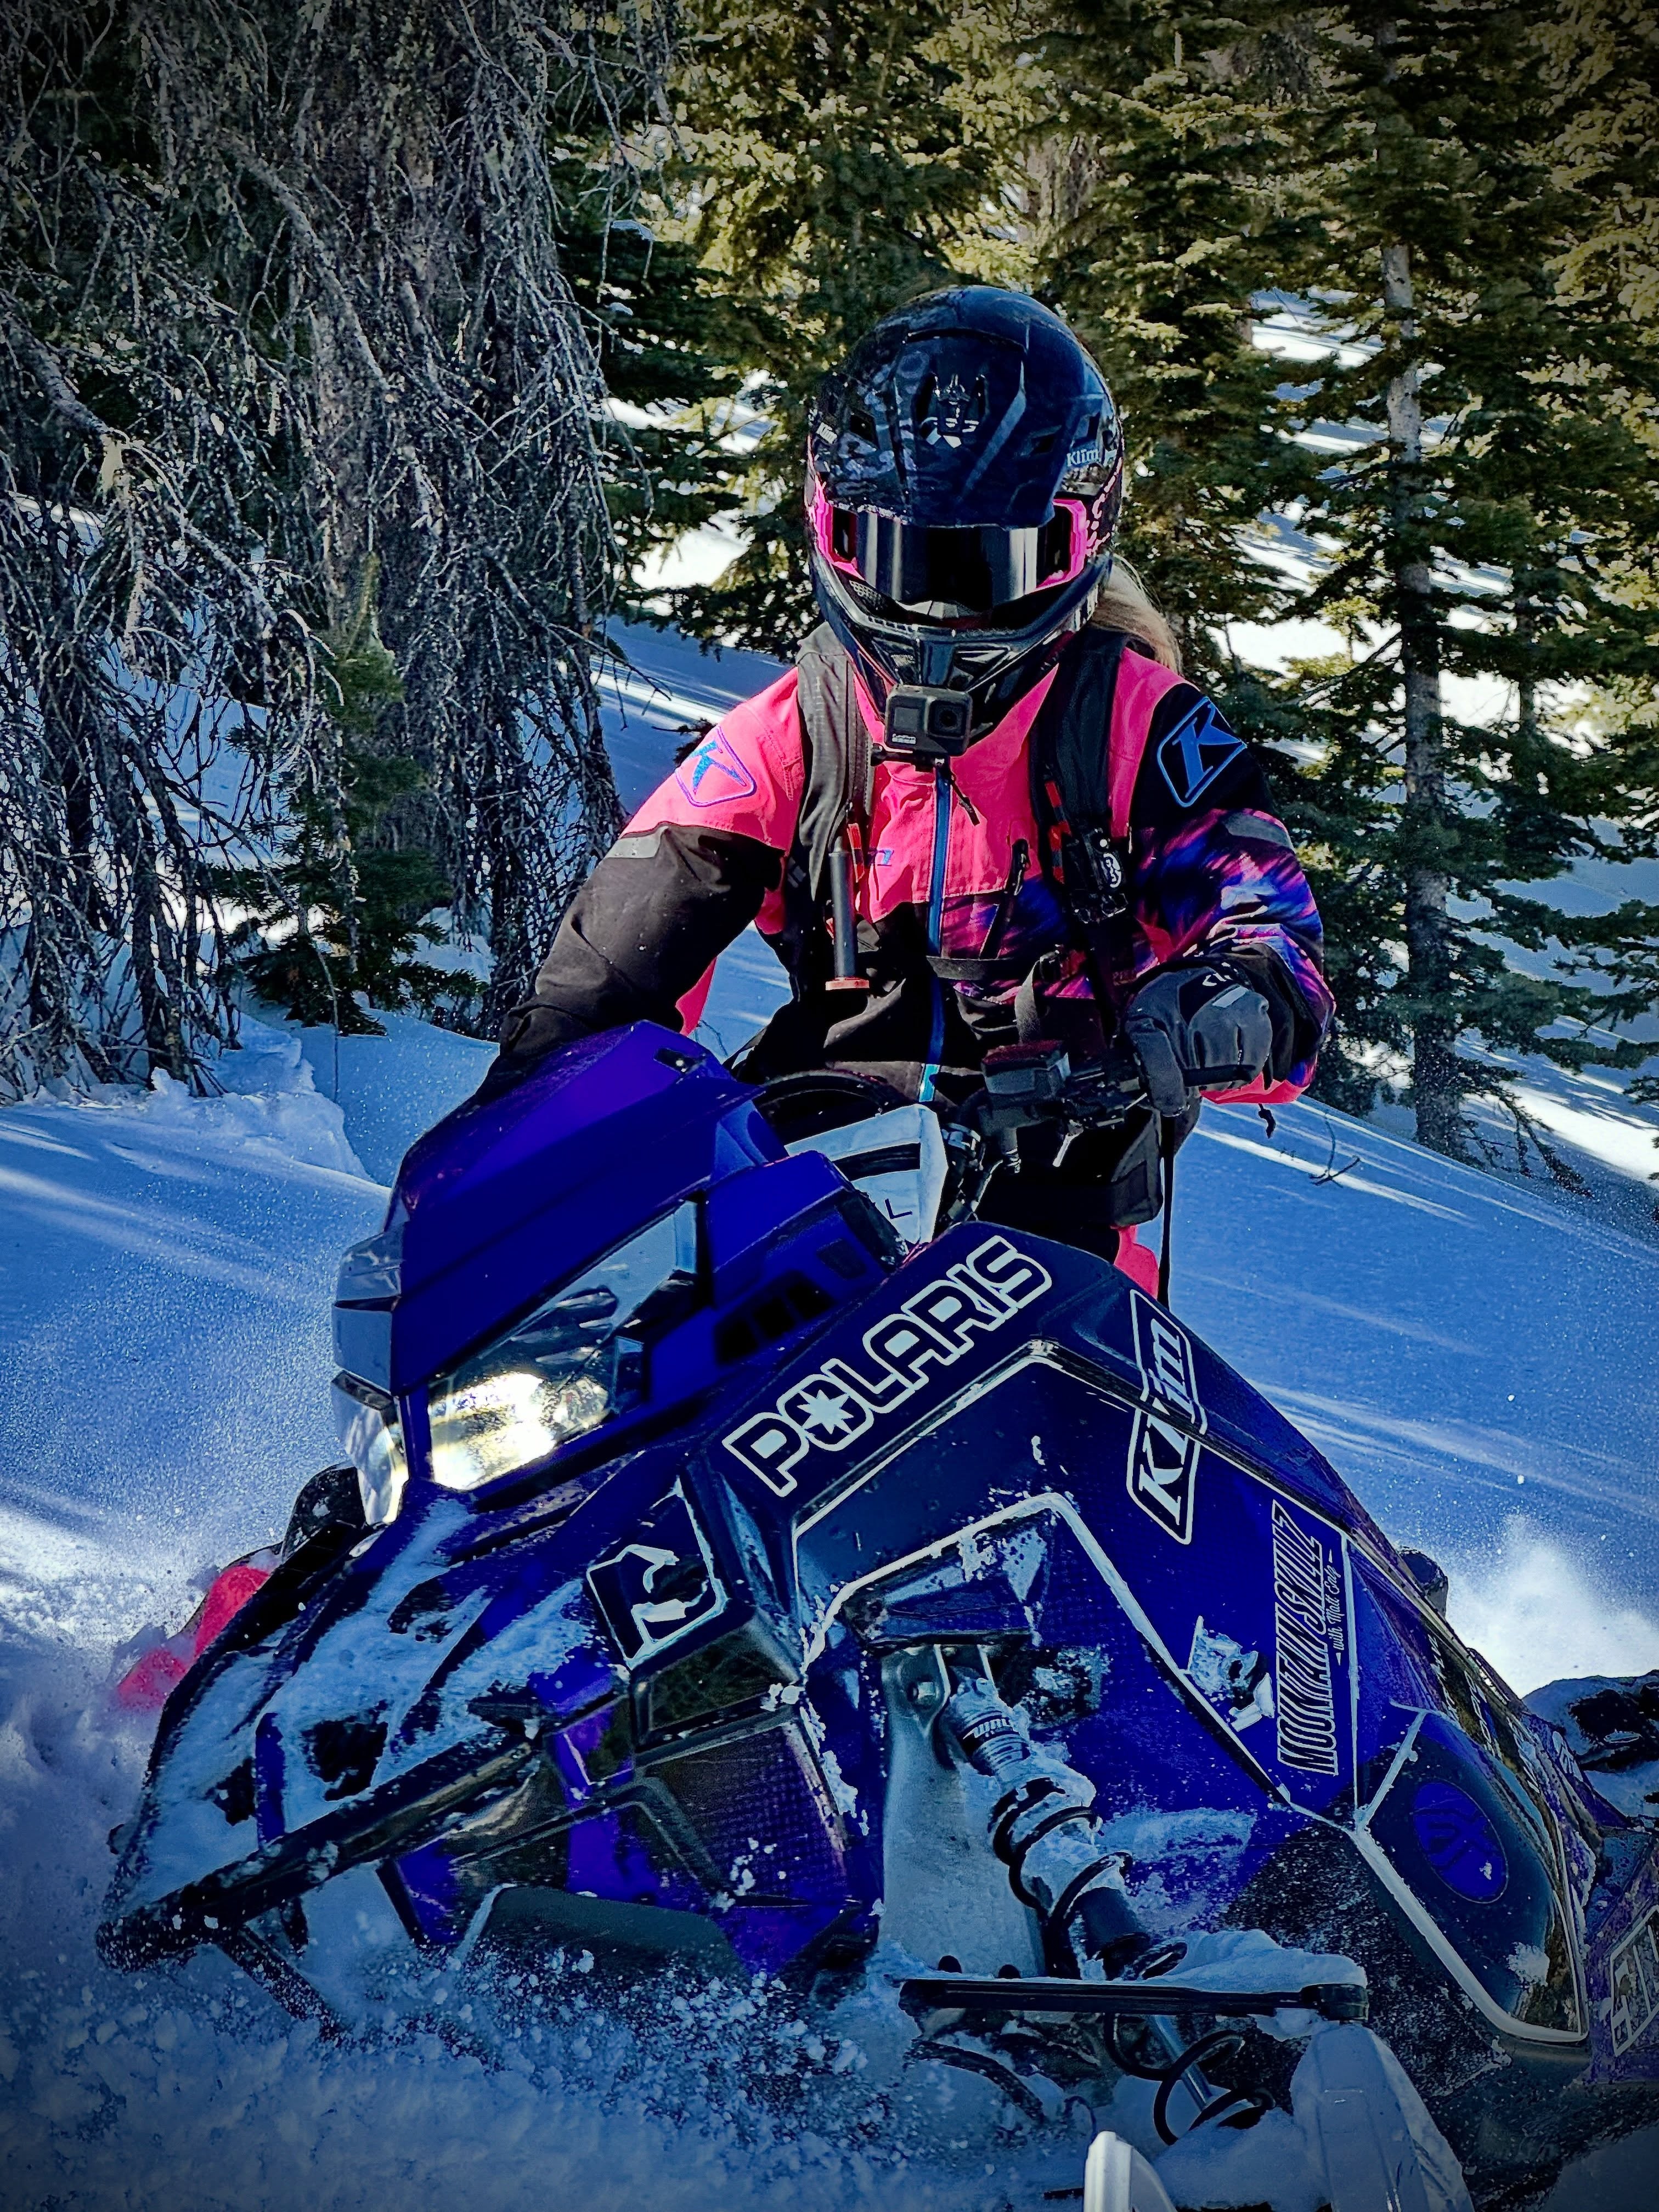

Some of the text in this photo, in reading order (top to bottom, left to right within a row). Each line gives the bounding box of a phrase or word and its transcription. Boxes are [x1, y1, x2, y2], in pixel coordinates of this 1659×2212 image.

[1066, 449, 1099, 466] Klim
[722, 1235, 1052, 1497] POLARIS
[1325, 1595, 1345, 1624] Matt
[1272, 1499, 1339, 1776] MOUNTAIN SKILLZ
[1328, 1627, 1344, 1650] with
